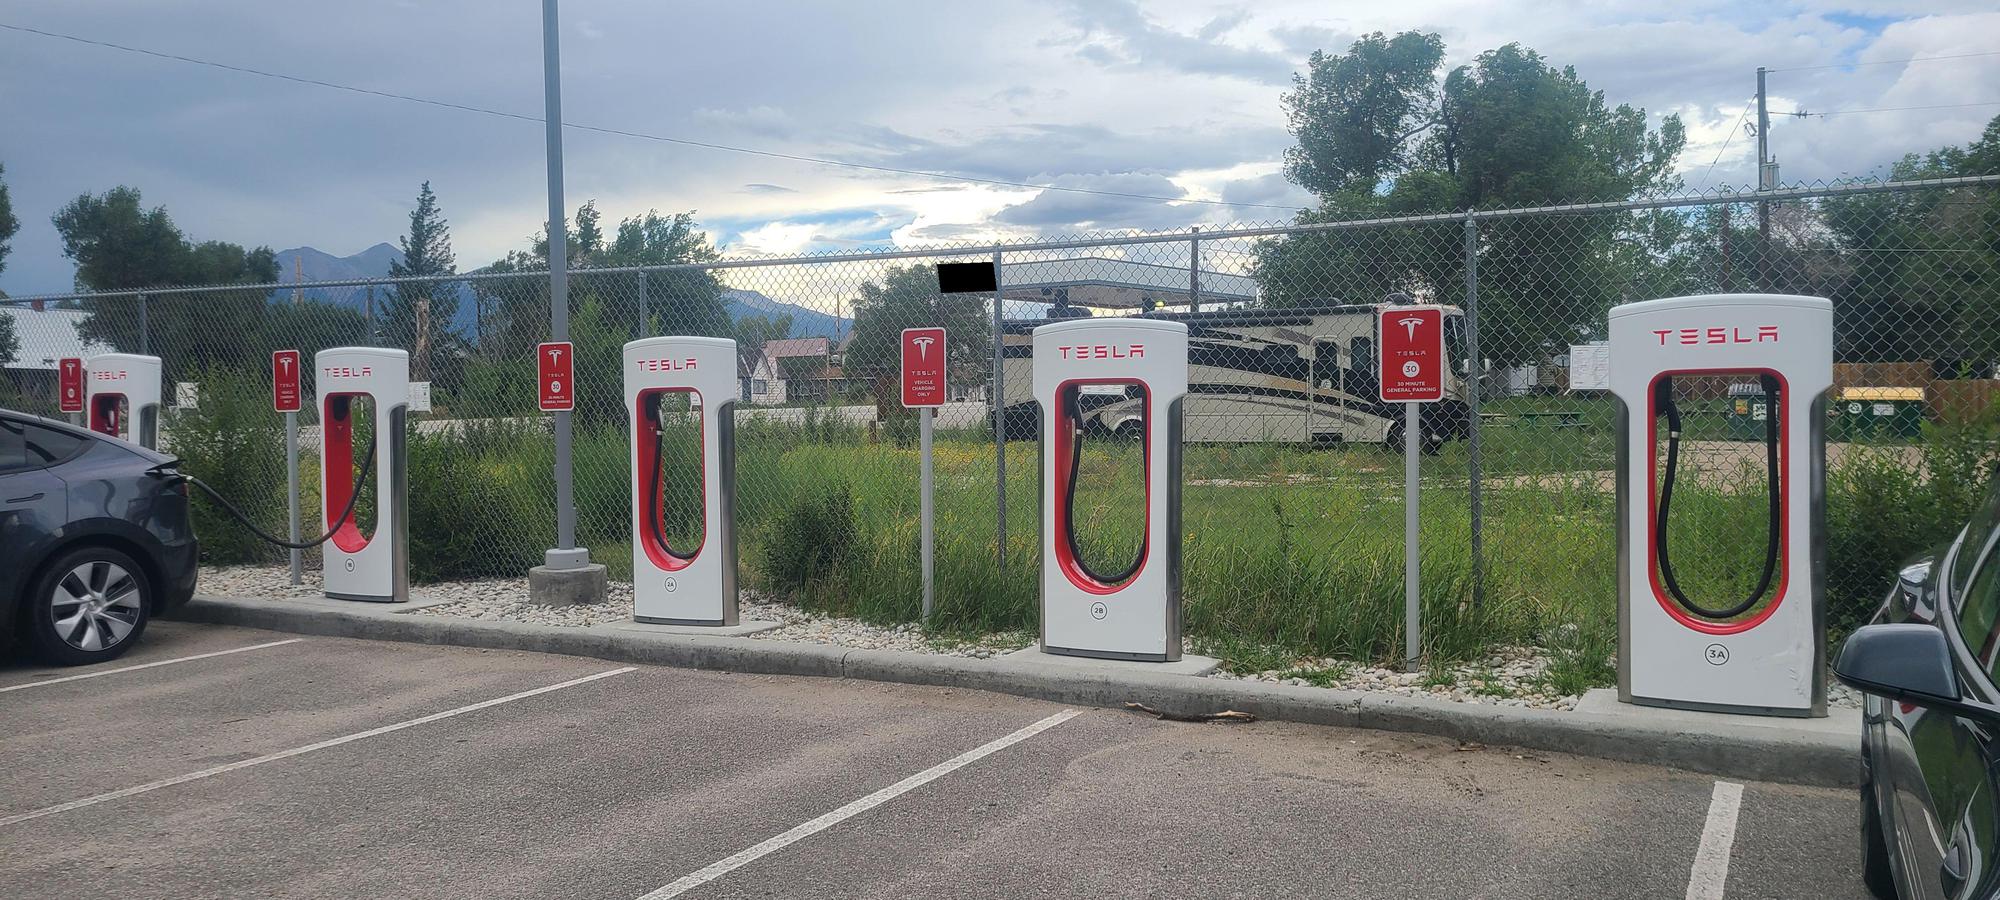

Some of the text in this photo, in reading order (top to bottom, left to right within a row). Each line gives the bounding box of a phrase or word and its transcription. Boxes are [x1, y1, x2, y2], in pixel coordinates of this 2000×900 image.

[1652, 326, 1778, 346] TESLA
[1058, 344, 1144, 359] TESLA
[637, 358, 697, 371] TESLA
[1405, 365, 1417, 373] 30
[92, 371, 128, 380] TESLA
[324, 367, 371, 377] TESLA
[1709, 649, 1726, 659] 3A
